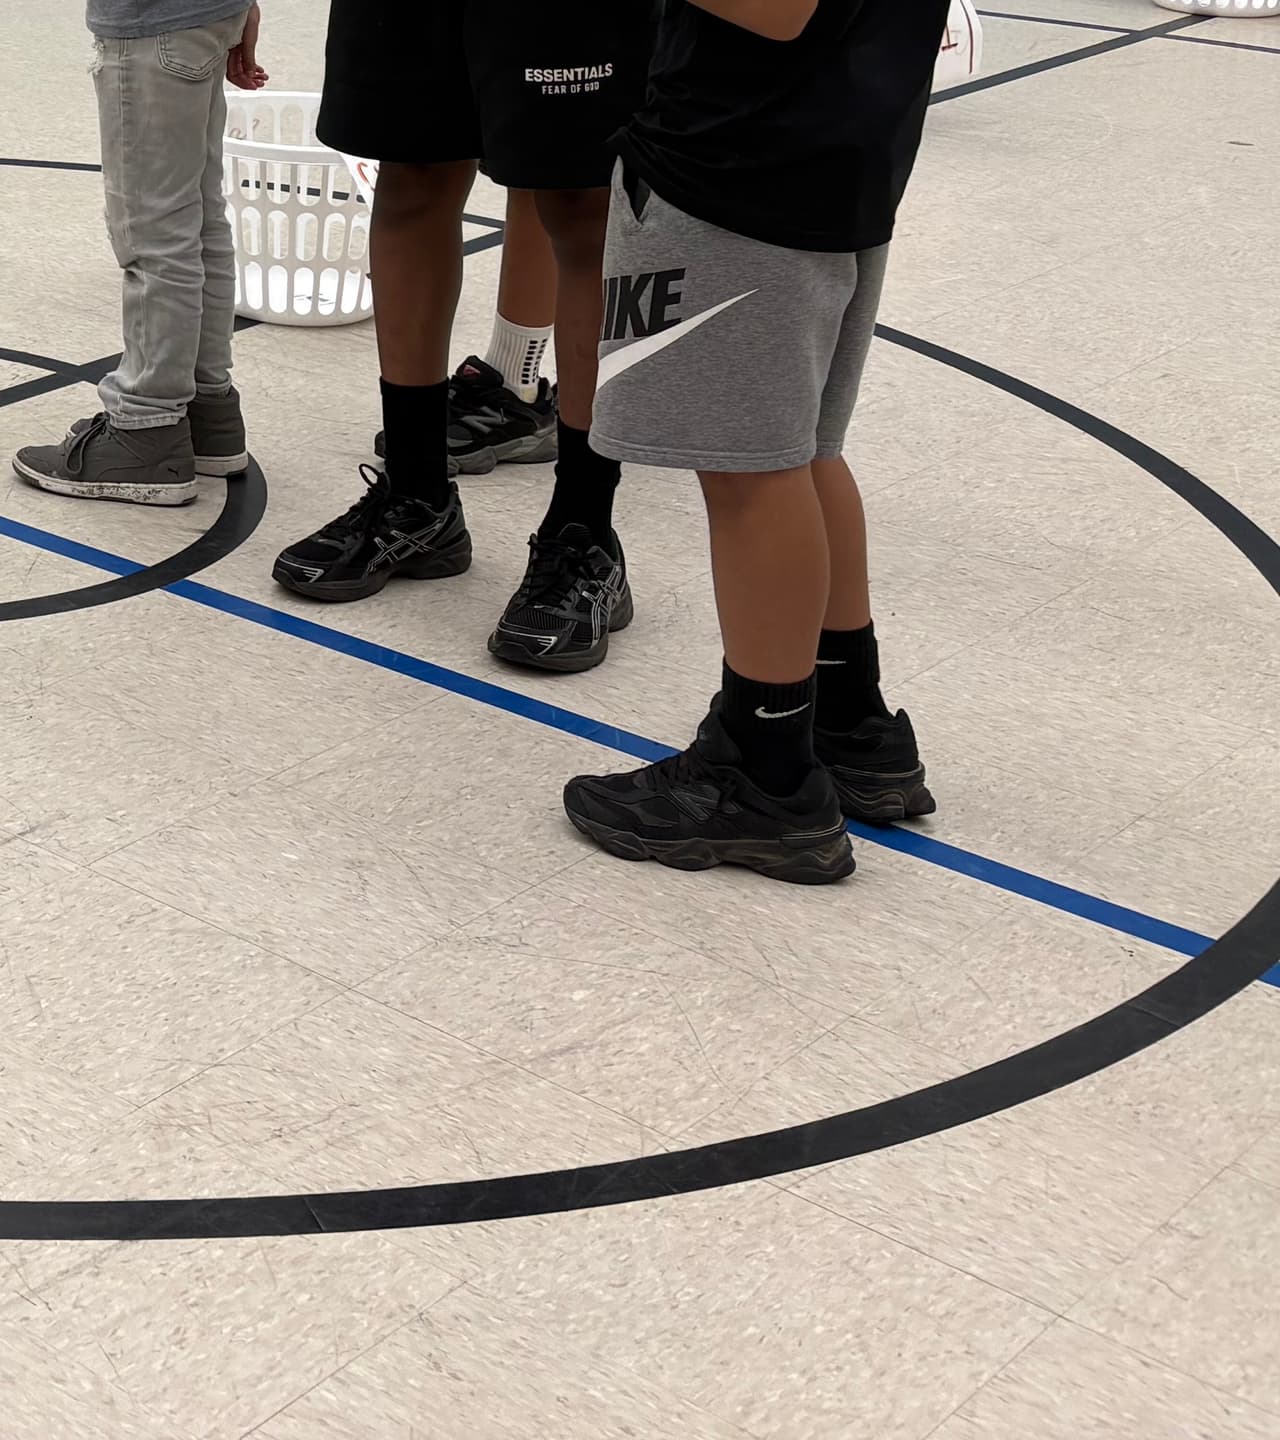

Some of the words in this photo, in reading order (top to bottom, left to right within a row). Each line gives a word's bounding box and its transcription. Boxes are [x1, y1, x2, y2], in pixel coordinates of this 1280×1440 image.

[524, 63, 613, 82] ESSENTIALS
[541, 85, 567, 95] FEAR
[570, 84, 582, 94] OF
[584, 81, 600, 92] GOD
[601, 267, 687, 342] IKE
